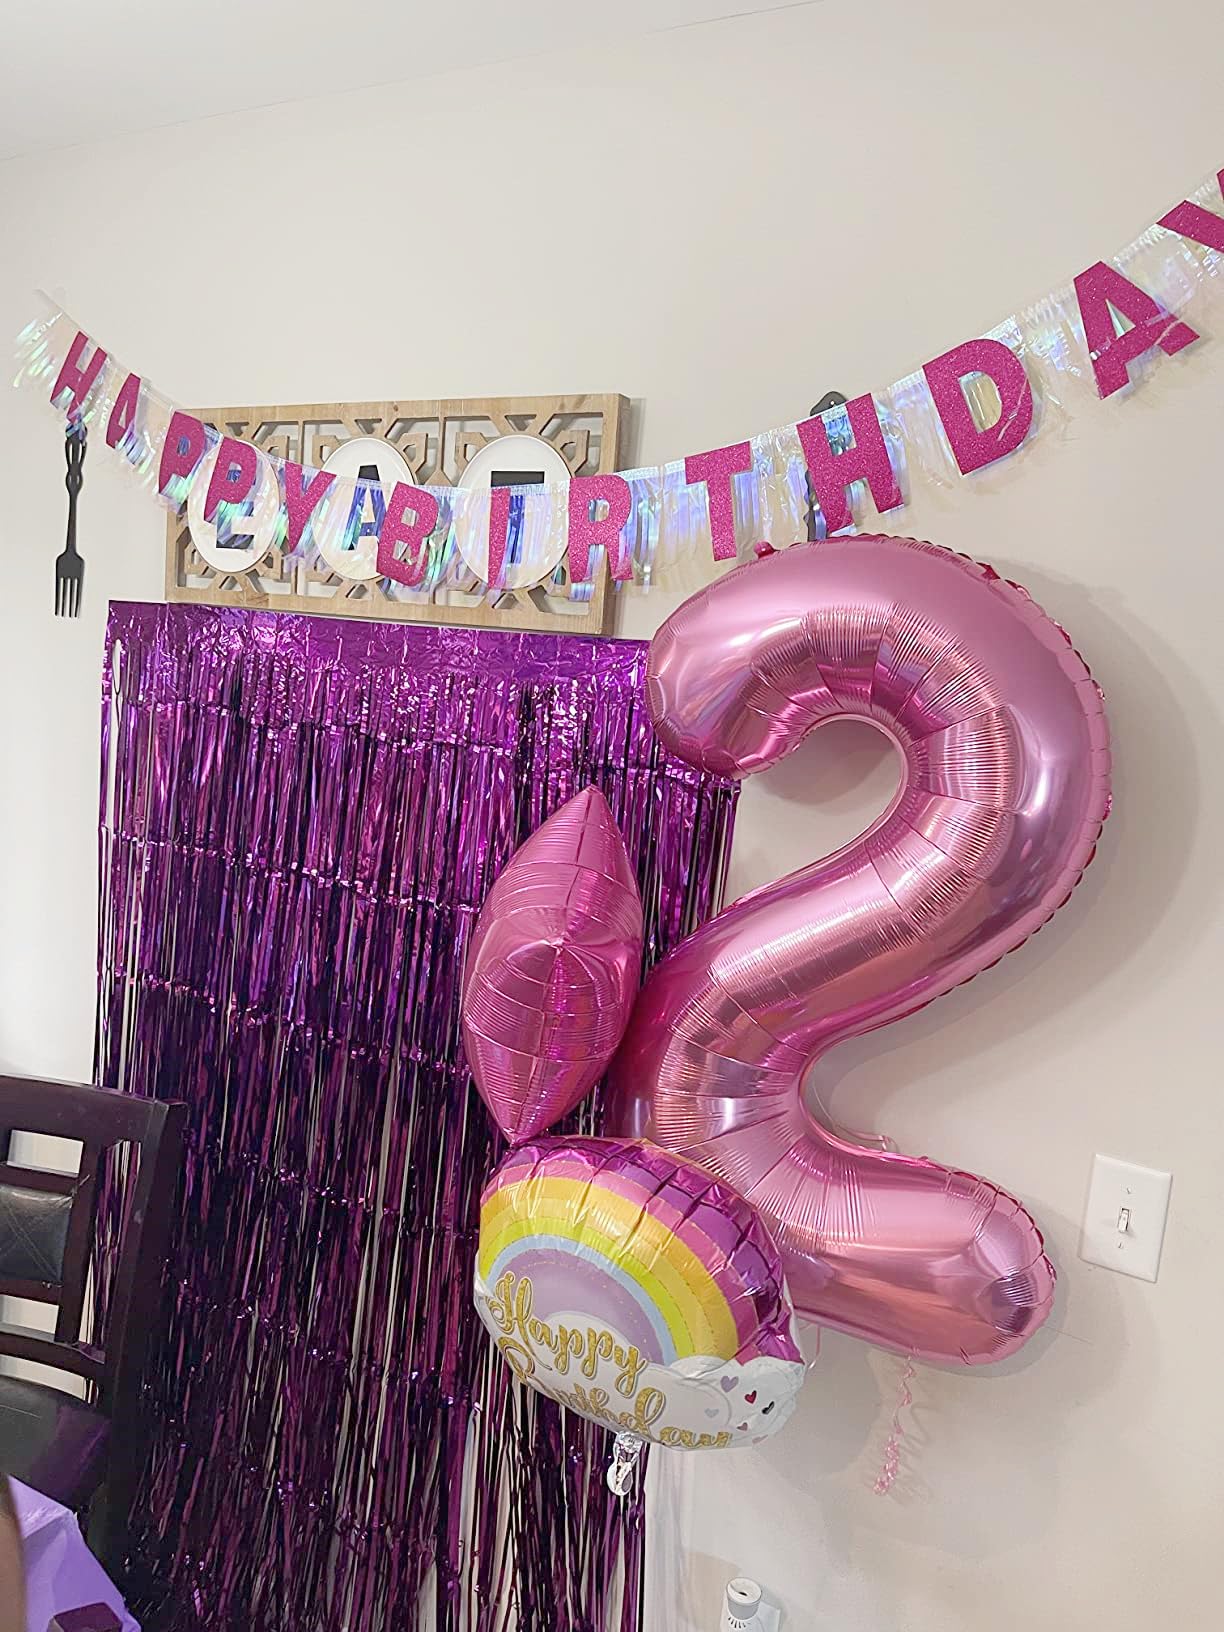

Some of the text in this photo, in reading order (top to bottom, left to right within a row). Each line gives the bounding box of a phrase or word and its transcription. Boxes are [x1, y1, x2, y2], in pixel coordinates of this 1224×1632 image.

[50, 331, 337, 552] HAPPY
[606, 534, 1111, 1364] 2
[486, 1272, 649, 1397] Happy
